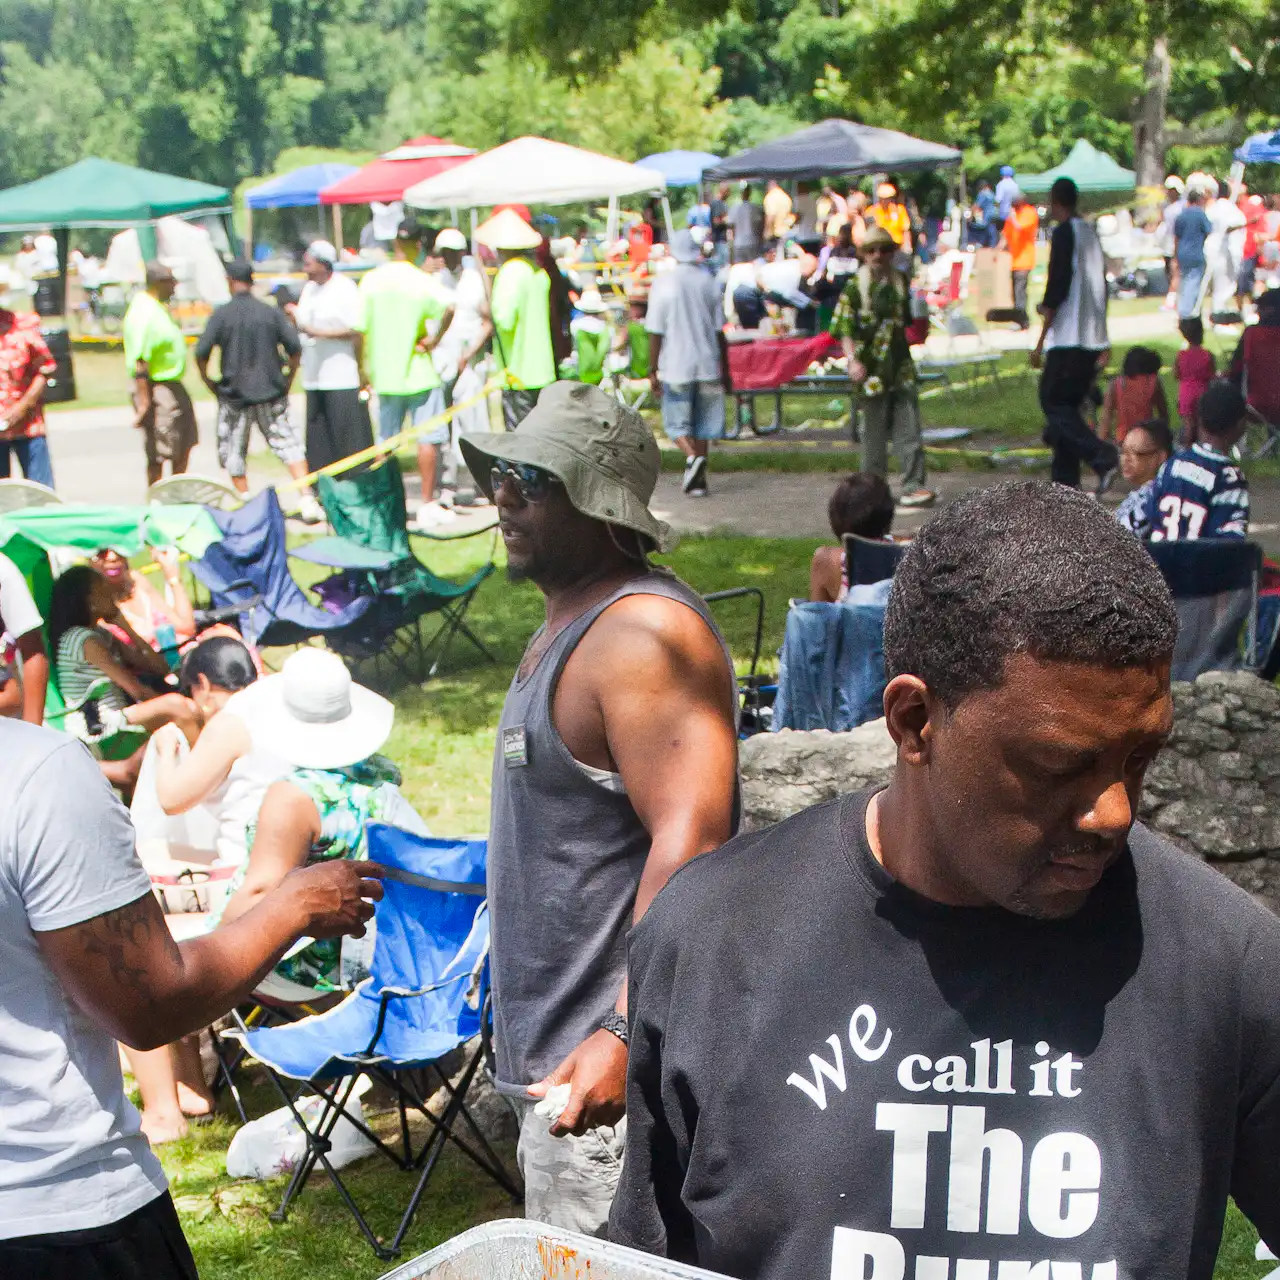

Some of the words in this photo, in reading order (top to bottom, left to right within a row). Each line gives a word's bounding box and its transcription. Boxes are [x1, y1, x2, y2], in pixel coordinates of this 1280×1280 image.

[1151, 494, 1208, 541] 37
[897, 1038, 1016, 1094] call
[1029, 1041, 1083, 1097] it
[875, 1102, 1101, 1238] The
